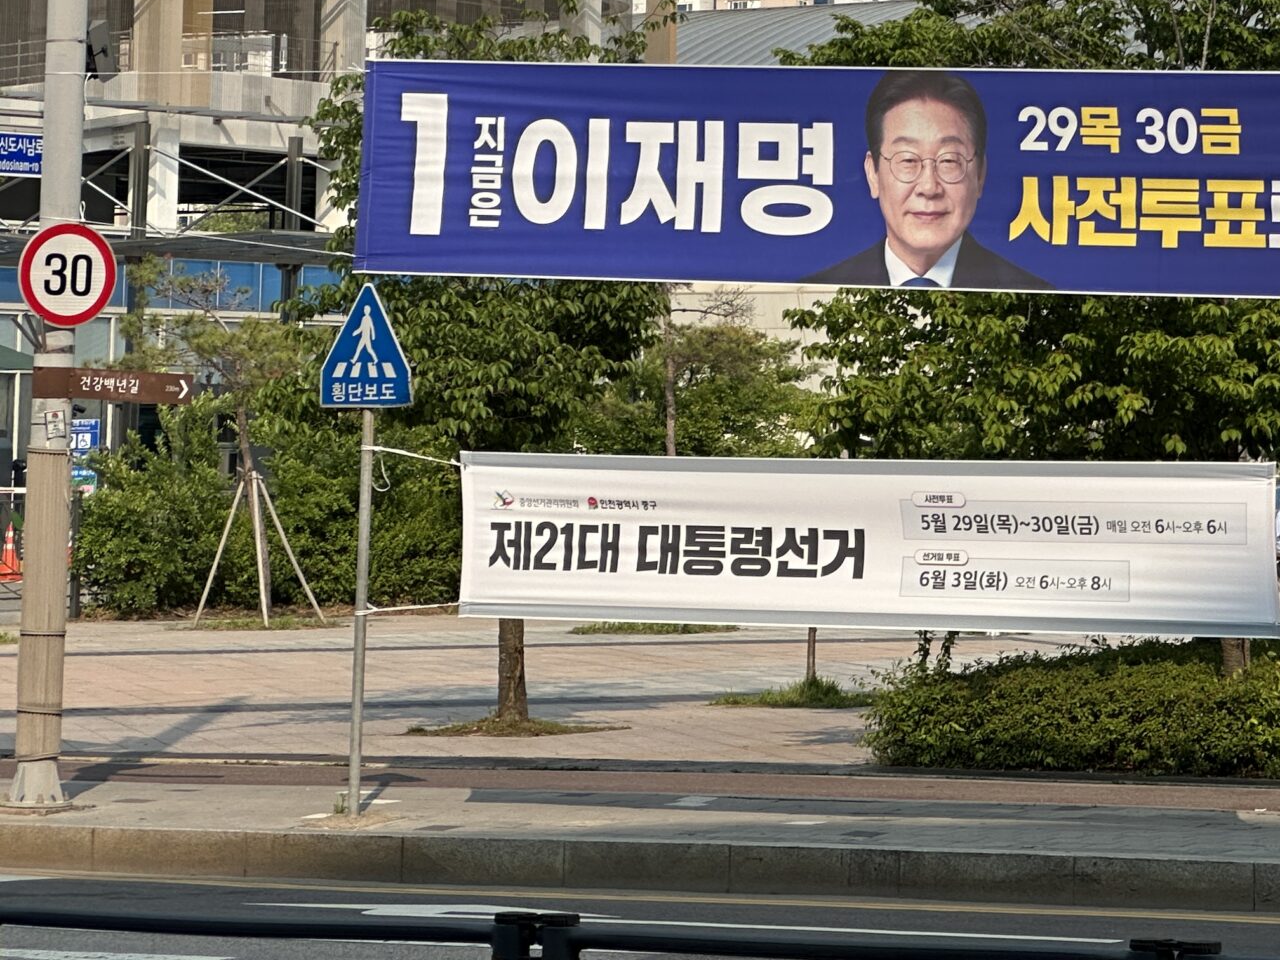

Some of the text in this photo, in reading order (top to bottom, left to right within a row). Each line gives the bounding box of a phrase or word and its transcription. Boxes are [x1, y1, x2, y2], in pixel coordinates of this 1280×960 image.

[1017, 105, 1242, 155] 29목 30금
[0, 137, 43, 156] 신도시남로
[400, 93, 448, 235] 1
[468, 116, 505, 228] 지금은
[512, 118, 834, 236] 이재명
[44, 253, 93, 297] 30
[80, 375, 139, 395] 건강백년길
[331, 382, 397, 402] 횡단보도
[519, 497, 579, 509] 중앙선거관리위원회
[599, 498, 657, 511] 인천광역시 중구
[924, 494, 953, 504] 사전투표
[921, 513, 947, 534] 5월
[1106, 519, 1127, 533] 매일
[1131, 520, 1151, 533] 오전
[1207, 519, 1227, 534] 6시
[488, 521, 866, 580] 제21대 대통령선거
[922, 552, 960, 562] 선거일 투표
[919, 569, 946, 590] 6월
[951, 570, 1008, 591] 3일(화)
[1015, 576, 1036, 589] 오전
[1090, 575, 1111, 591] 8시
